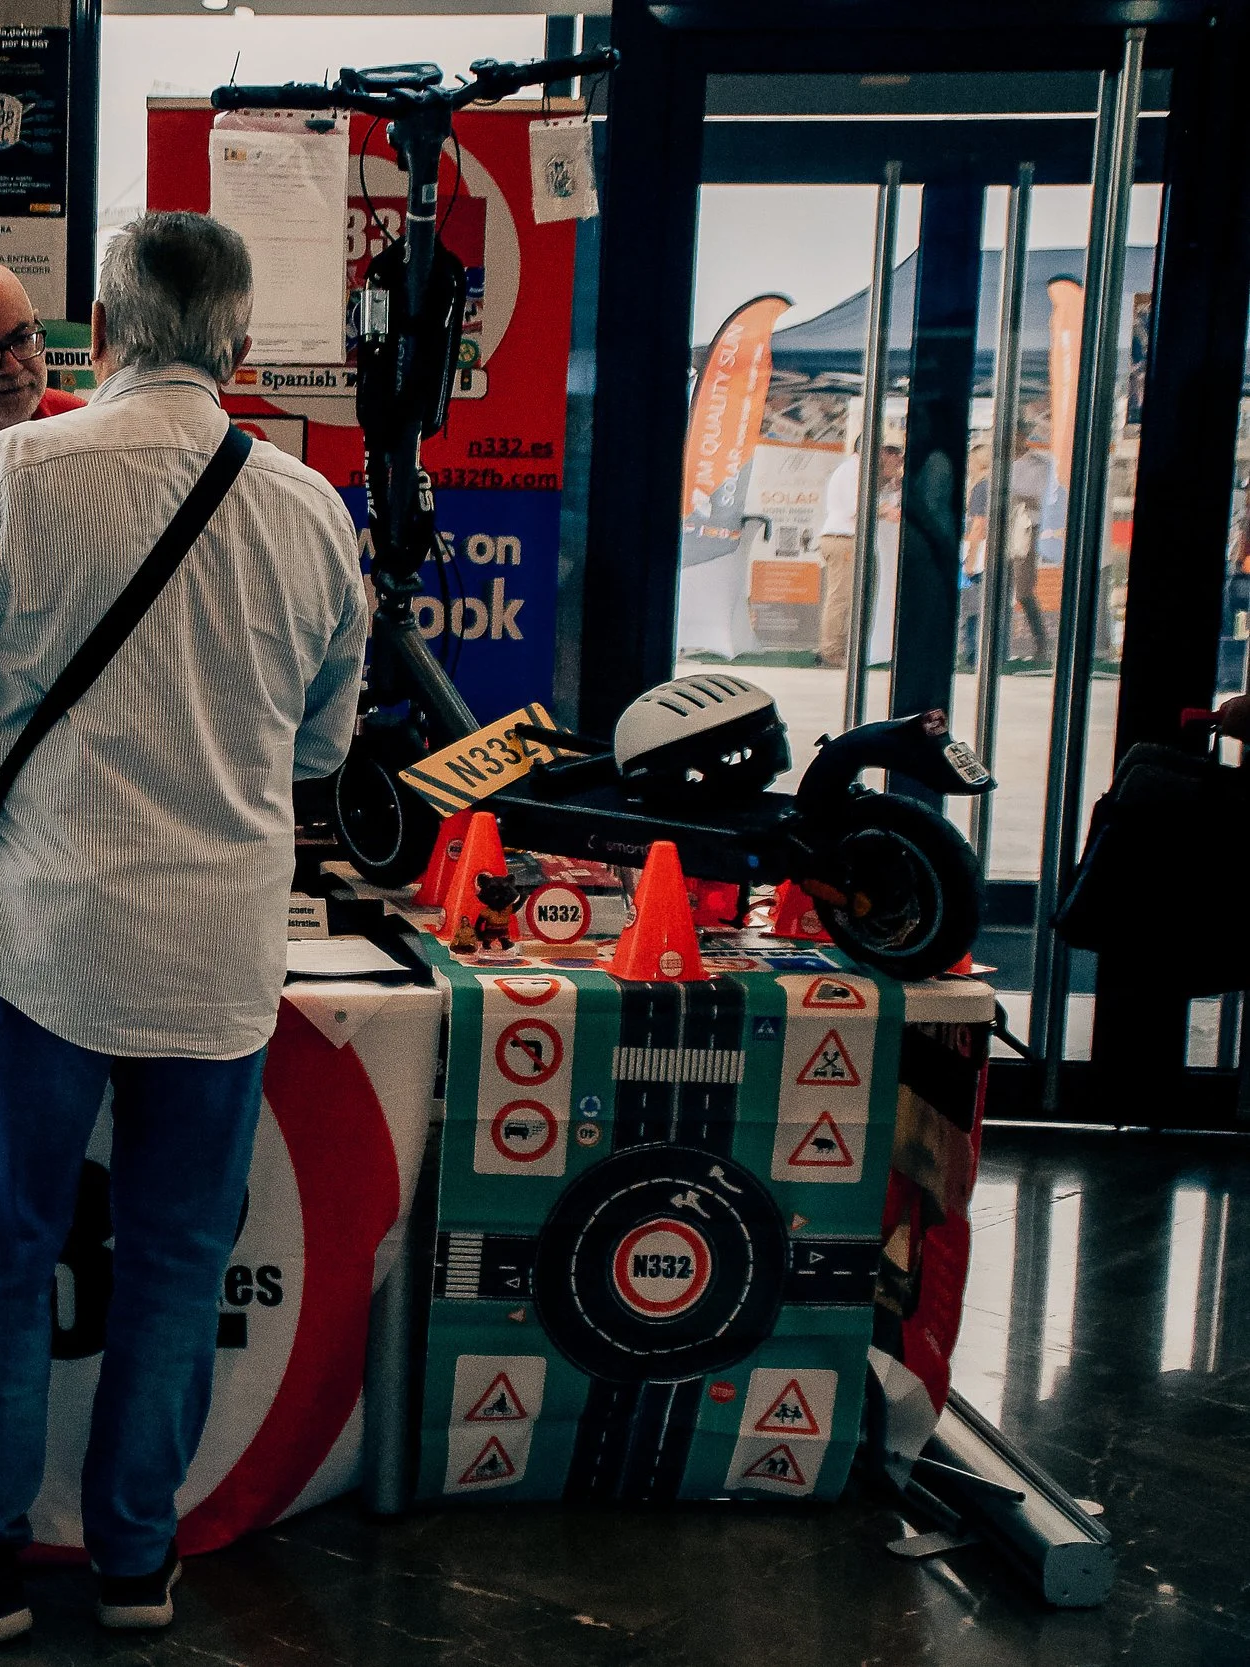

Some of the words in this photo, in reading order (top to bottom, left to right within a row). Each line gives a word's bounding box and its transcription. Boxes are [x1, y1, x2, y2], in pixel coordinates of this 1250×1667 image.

[346, 207, 401, 261] 33
[8, 254, 50, 263] ENTRADA
[261, 372, 338, 389] Spanish
[700, 369, 732, 457] QUALITY
[468, 437, 554, 457] n332.es
[466, 533, 522, 566] on
[444, 727, 540, 789] N332
[288, 907, 315, 915] cooter
[537, 904, 581, 922] N332
[632, 1254, 693, 1279] N332
